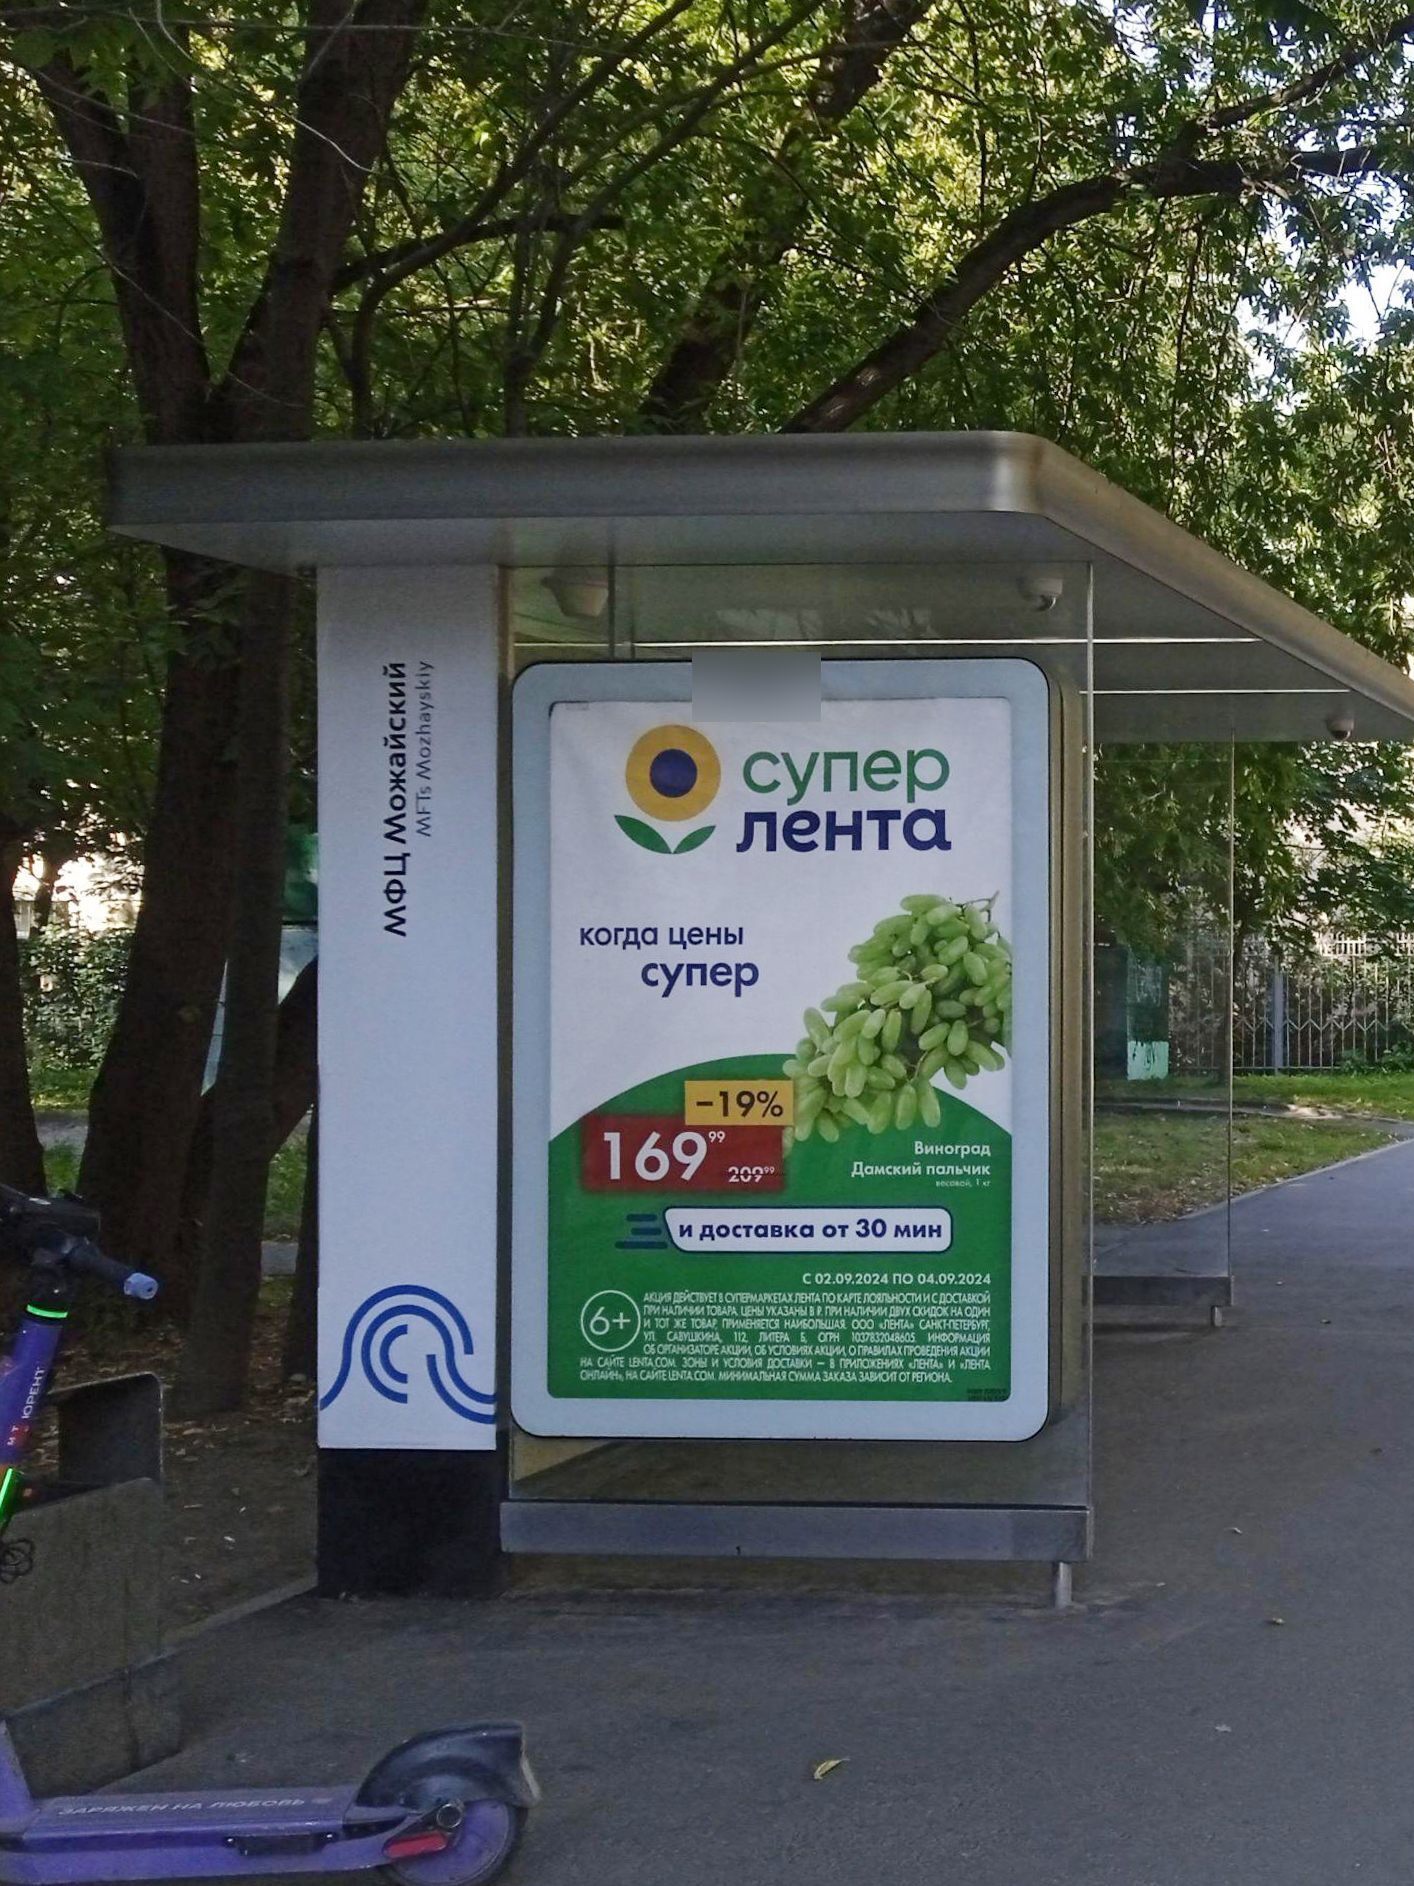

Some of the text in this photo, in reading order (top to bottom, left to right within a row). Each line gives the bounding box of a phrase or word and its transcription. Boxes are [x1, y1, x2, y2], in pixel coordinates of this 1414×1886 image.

[415, 660, 435, 837] MFTs Mozhayskiy
[742, 748, 950, 806] супер
[383, 662, 410, 937] МФЦ Можайский
[736, 808, 952, 853] лента
[579, 925, 743, 951] когда цены
[641, 959, 759, 997] супер
[696, 1091, 784, 1118] -19%
[914, 1141, 991, 1159] Виноград
[851, 1161, 990, 1178] Дамский пальчик
[679, 1219, 942, 1242] и доставка от 30 мин
[802, 1273, 991, 1285] С 02.09.2024 ПО 04.09.2024
[643, 1292, 671, 1303] АКЦИЯ
[673, 1290, 717, 1303] ДЕЙСТВУЕТ
[725, 1293, 793, 1303] СУПЕРМАРКЕТАХ
[794, 1293, 820, 1303] ЛЕНТА
[822, 1293, 835, 1303] ПО
[837, 1293, 861, 1303] КАРТЕ
[863, 1293, 922, 1304] ЛОЯЛЬНОСТИ
[939, 1291, 990, 1304] ДОСТАВКОЙ
[589, 1306, 631, 1335] 6+
[643, 1306, 661, 1315] ПРИ
[662, 1306, 705, 1315] НАЛИЧИИ
[741, 1306, 764, 1317] ЦЕНЫ
[765, 1306, 807, 1316] УКАЗАНЫ
[825, 1307, 842, 1316] ПРИ
[844, 1307, 888, 1316] НАЛИЧИИ
[889, 1307, 911, 1317] ДВУХ
[912, 1307, 948, 1317] СКИДОК
[951, 1307, 963, 1317] НА
[965, 1307, 990, 1318] ОДИН
[655, 1318, 669, 1328] ТОТ
[674, 1318, 686, 1328] ЖЕ
[722, 1319, 780, 1329] ПРИМЕНЯЕТСЯ
[852, 1320, 874, 1330] ООО
[759, 1332, 790, 1342] ЛИТЕРА
[818, 1333, 840, 1342] ОГРН
[928, 1333, 990, 1344] ИНФОРМАЦИЯ
[643, 1345, 656, 1355] ОБ
[657, 1345, 719, 1355] ОРГАНИЗАТОРЕ
[754, 1345, 767, 1355] ОБ
[768, 1345, 813, 1355] УСЛОВИЯХ
[858, 1346, 902, 1356] ПРАВИЛАХ
[904, 1346, 957, 1357] ПРОВЕДЕНИЯ
[959, 1346, 990, 1357] АКЦИИ
[580, 1357, 593, 1367] НА
[597, 1354, 624, 1368] САЙТЕ
[682, 1357, 707, 1368] ЗОНЫ
[724, 1358, 762, 1368] УСЛОВИЯ
[767, 1358, 812, 1369] ДОСТАВКИ
[840, 1359, 904, 1369] ПРИЛОЖЕНИЯХ
[626, 1370, 637, 1380] НА
[640, 1368, 667, 1380] САЙТЕ
[719, 1371, 787, 1381] МИНИМАЛЬНАЯ
[788, 1371, 821, 1381] СУММА
[822, 1372, 857, 1382] ЗАКАЗА
[858, 1372, 898, 1382] ЗАВИСИТ
[899, 1372, 910, 1383] ОТ
[20, 1366, 46, 1420] ЮРЕНТ
[58, 1797, 306, 1816] ЗАРЯЖЕН НА ЛЮБОВЬ
